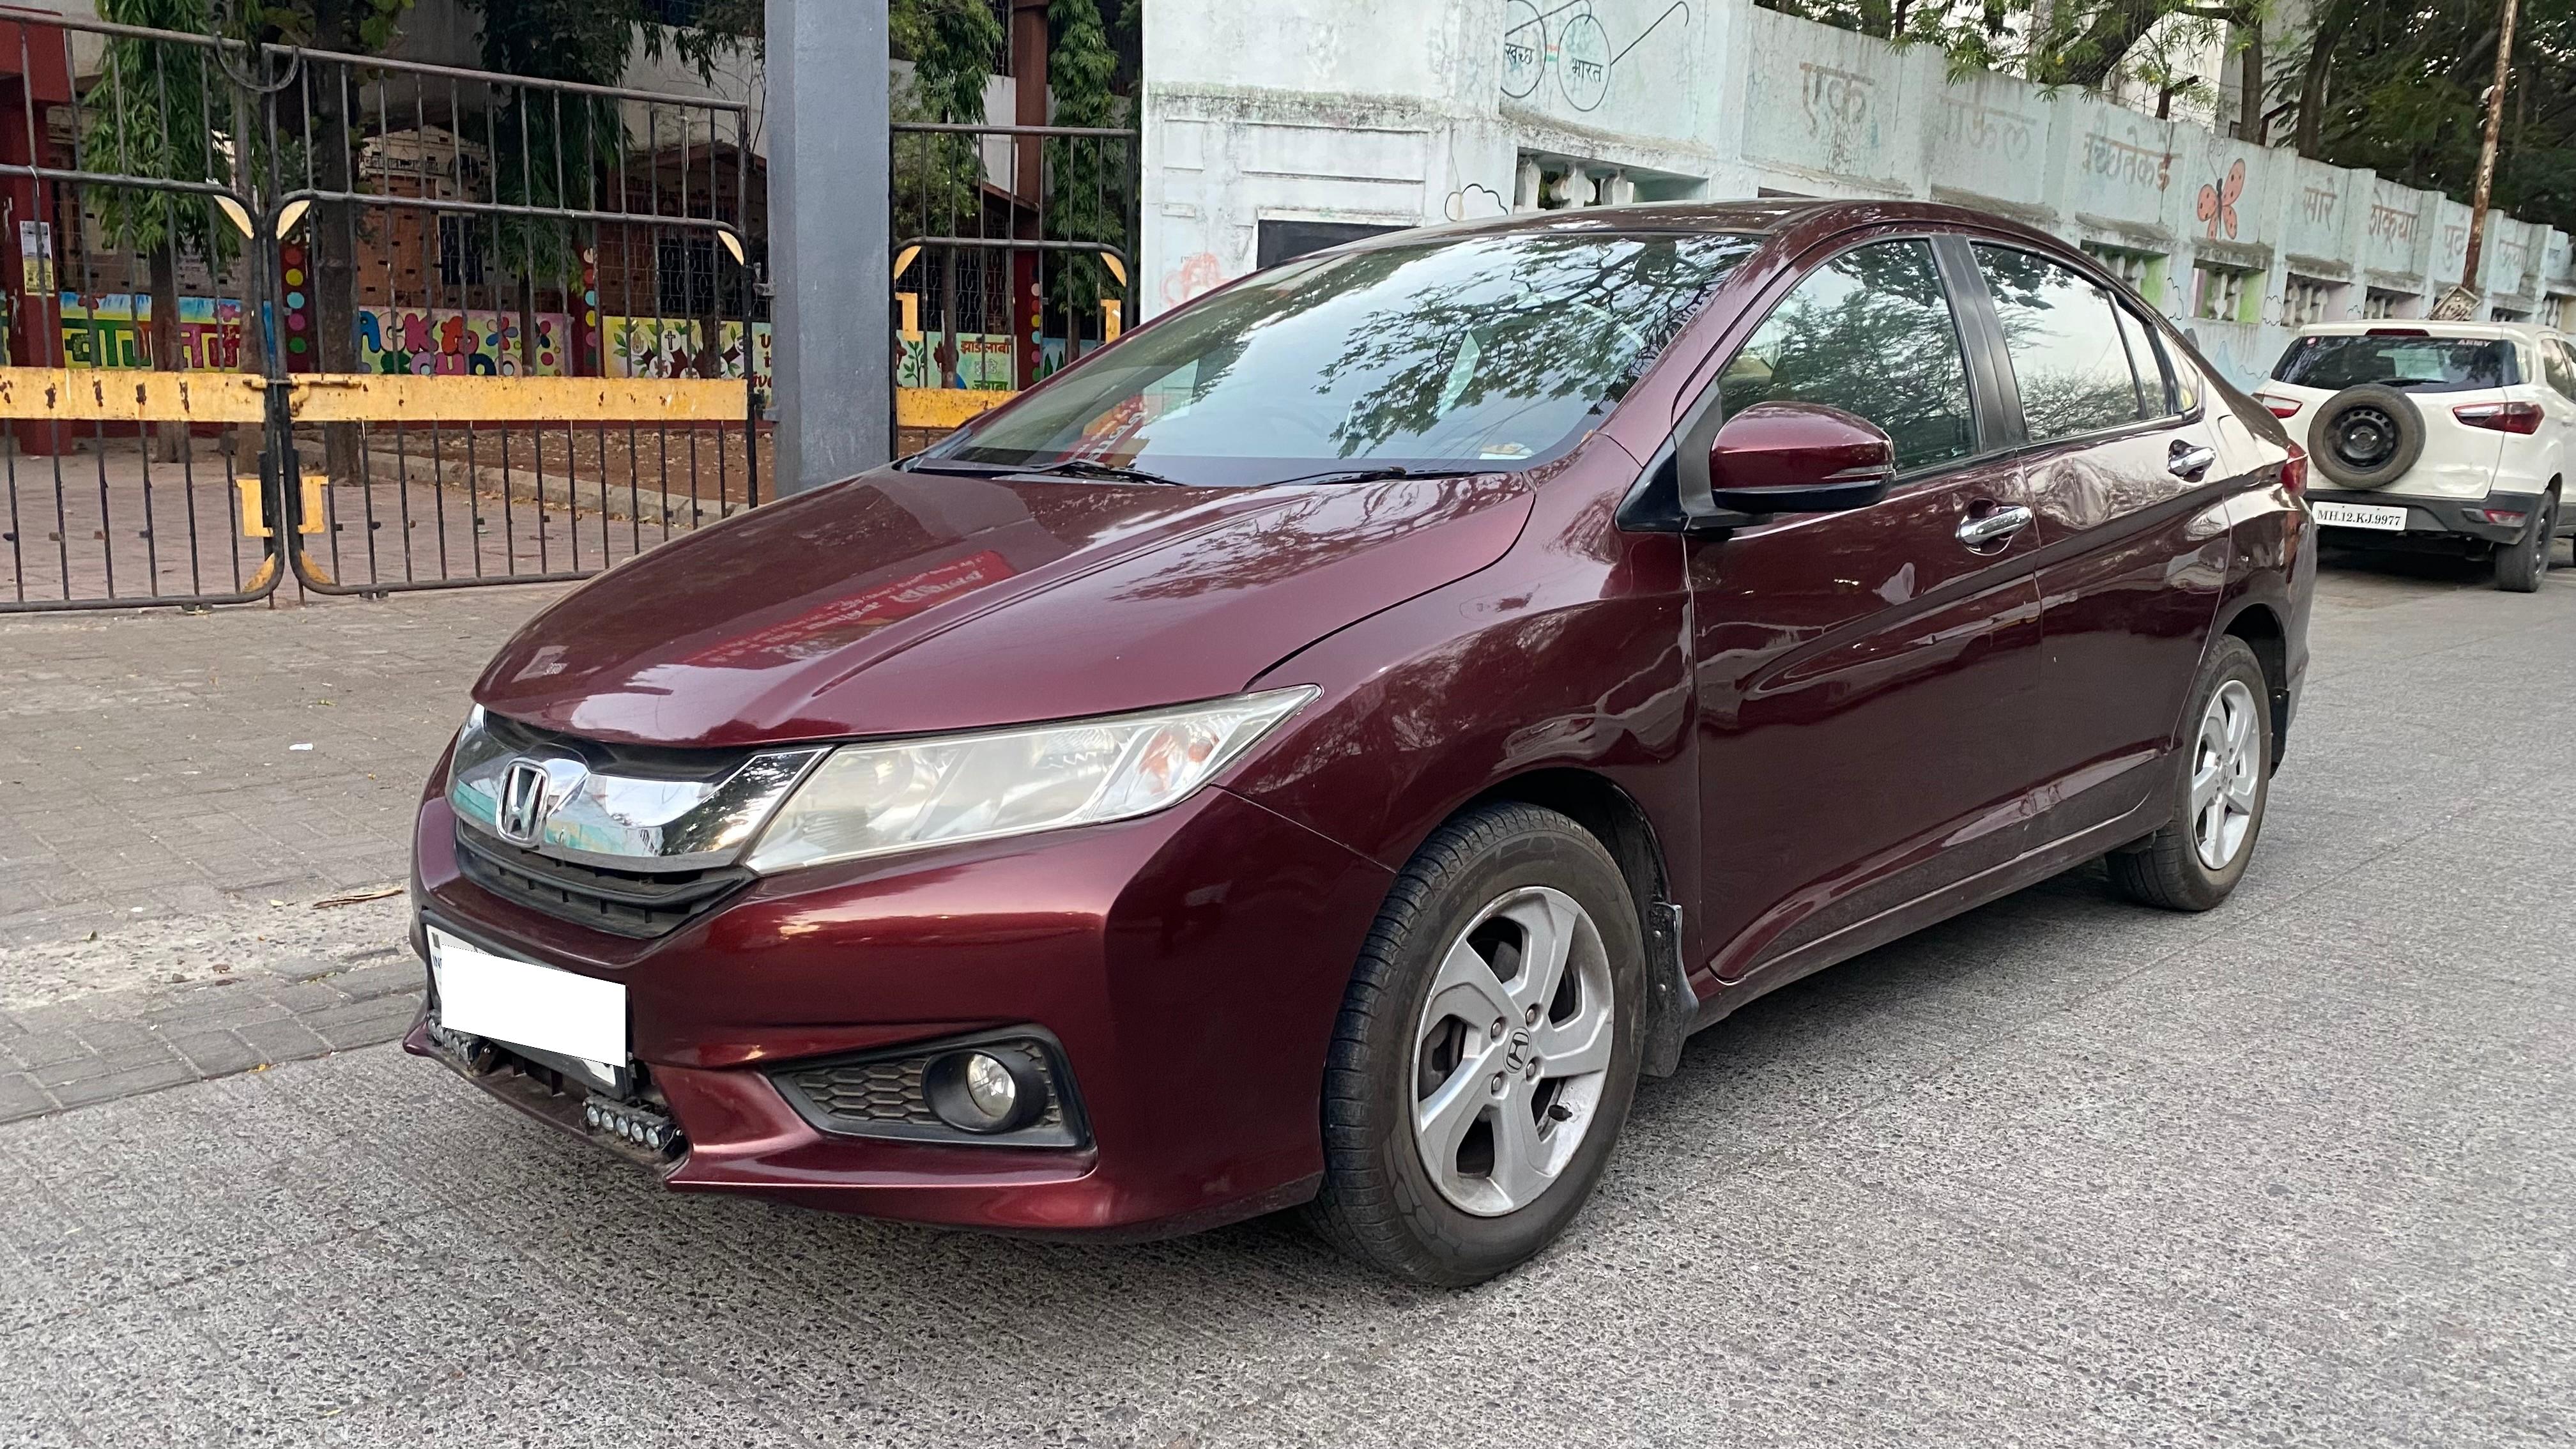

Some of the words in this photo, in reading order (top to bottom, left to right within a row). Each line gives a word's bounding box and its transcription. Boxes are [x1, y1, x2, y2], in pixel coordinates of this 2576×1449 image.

[1572, 57, 1604, 84] भारत
[358, 310, 439, 353] ACK
[2457, 339, 2492, 347] ARMY
[2317, 510, 2401, 526] MH.12.KJ.9977
